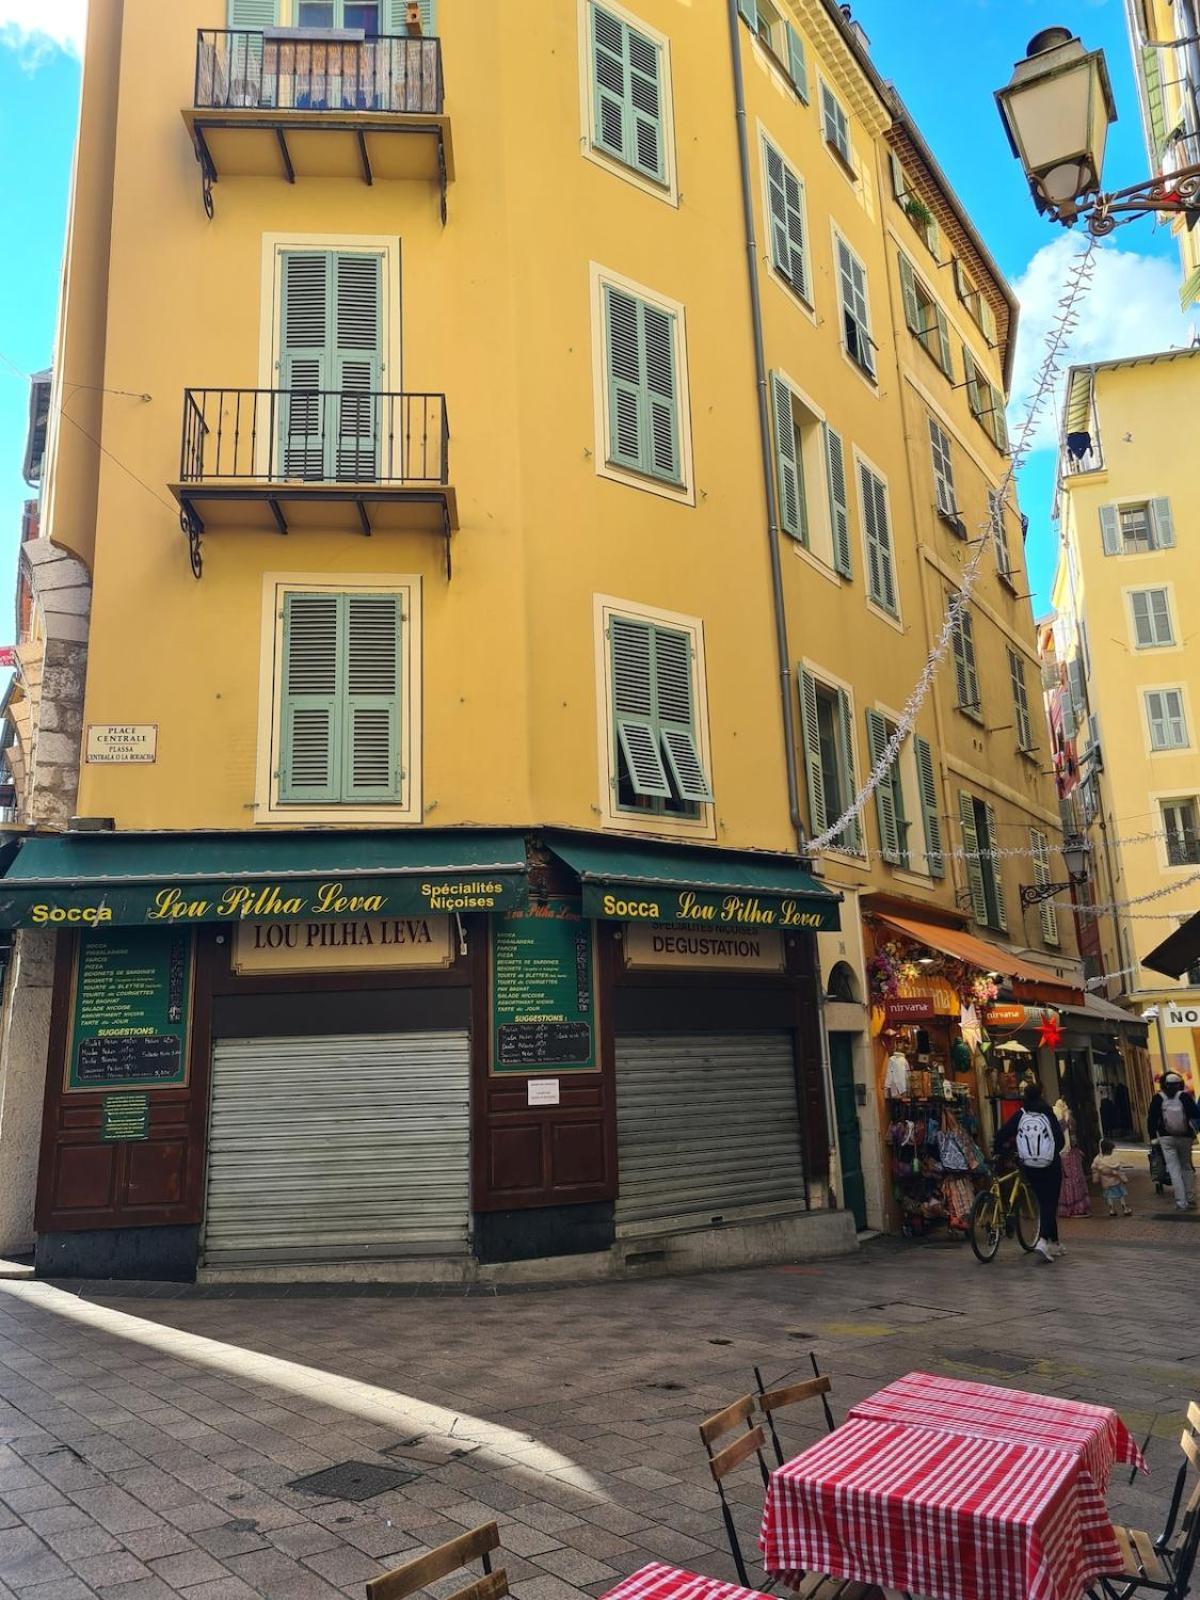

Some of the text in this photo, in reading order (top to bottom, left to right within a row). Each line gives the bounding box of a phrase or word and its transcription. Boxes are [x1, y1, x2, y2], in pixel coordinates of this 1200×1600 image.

[421, 881, 503, 899] Spécialités
[148, 883, 389, 919] Lou Pilha Leva
[430, 895, 495, 911] Niçoises
[603, 895, 659, 918] Socca
[676, 891, 824, 928] Lou Pilha Leva
[31, 904, 112, 922] Socca
[254, 919, 433, 949] LOU PILHA LEVA
[652, 935, 761, 958] DEGUSTATION
[889, 1002, 929, 1013] nirvana
[986, 1010, 1020, 1020] nirvana
[1170, 1010, 1198, 1023] NO
[515, 1014, 564, 1023] SUGGESTIONS
[98, 1027, 154, 1036] SUGGESTIONS
